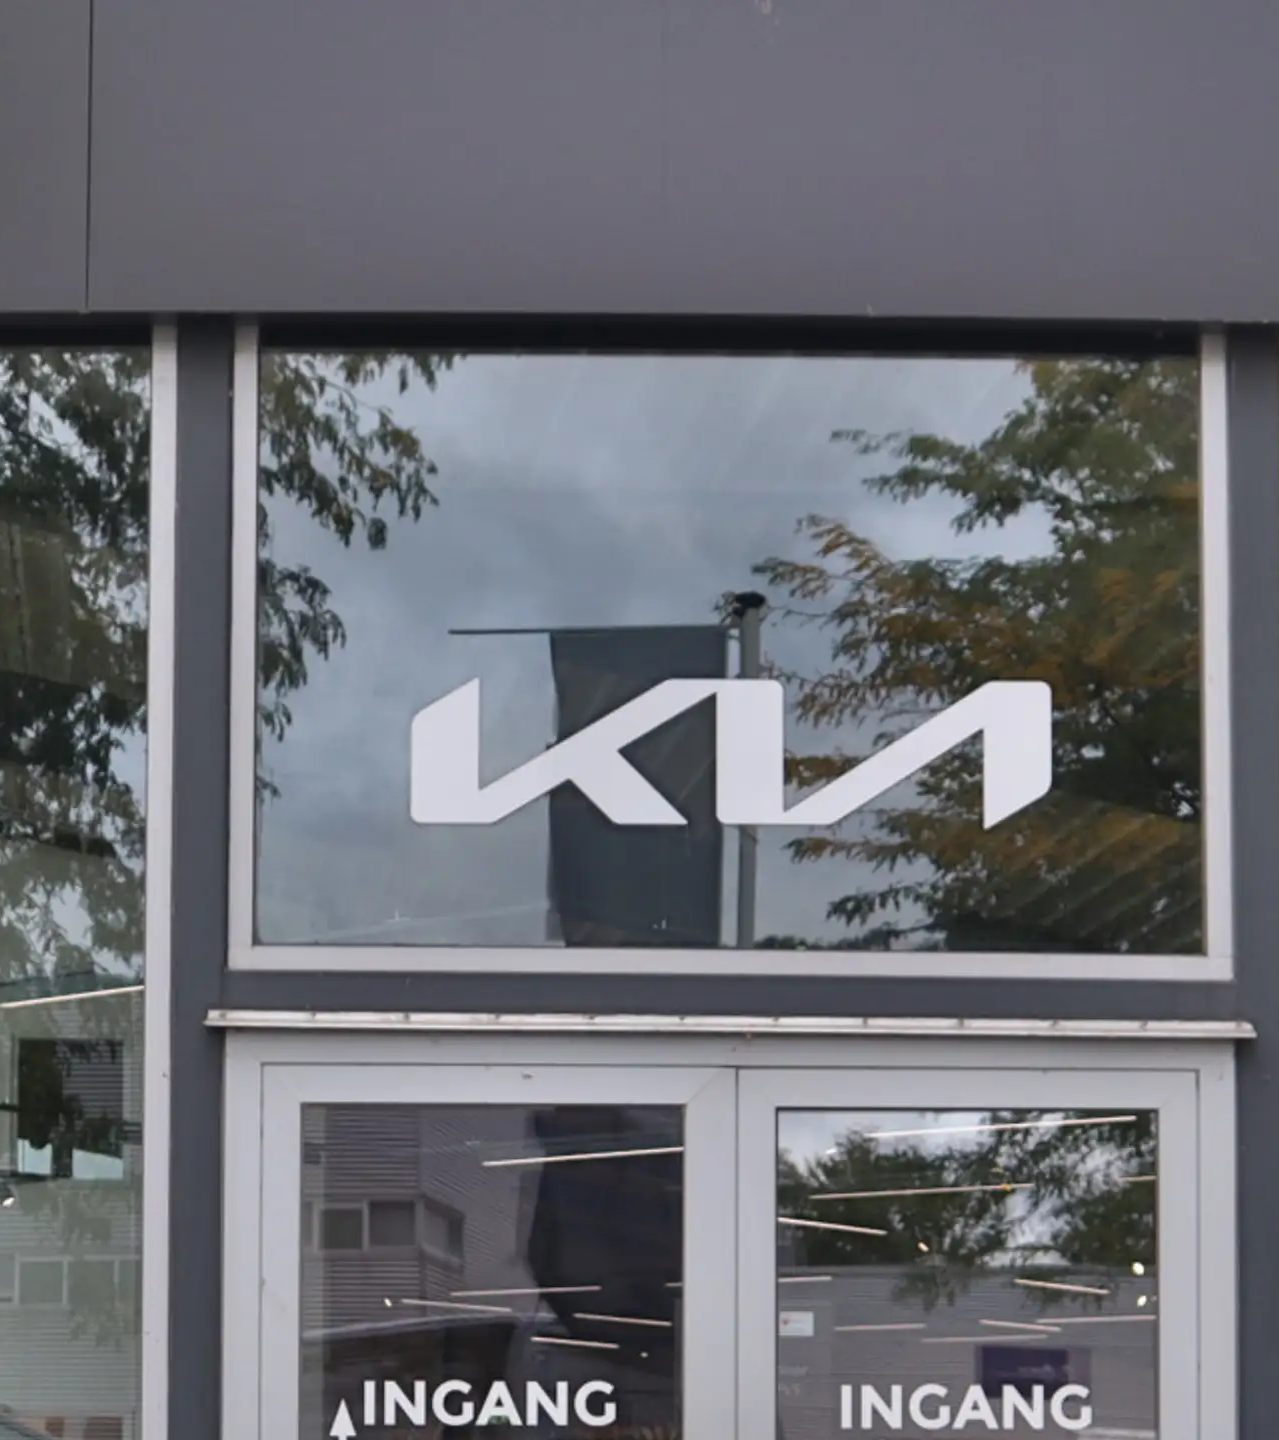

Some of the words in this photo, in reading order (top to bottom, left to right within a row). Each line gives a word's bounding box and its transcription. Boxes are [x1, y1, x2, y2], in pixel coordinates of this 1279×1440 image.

[409, 676, 1053, 829] KIA
[363, 1380, 617, 1426] INGANG
[840, 1383, 1093, 1431] INGANG
